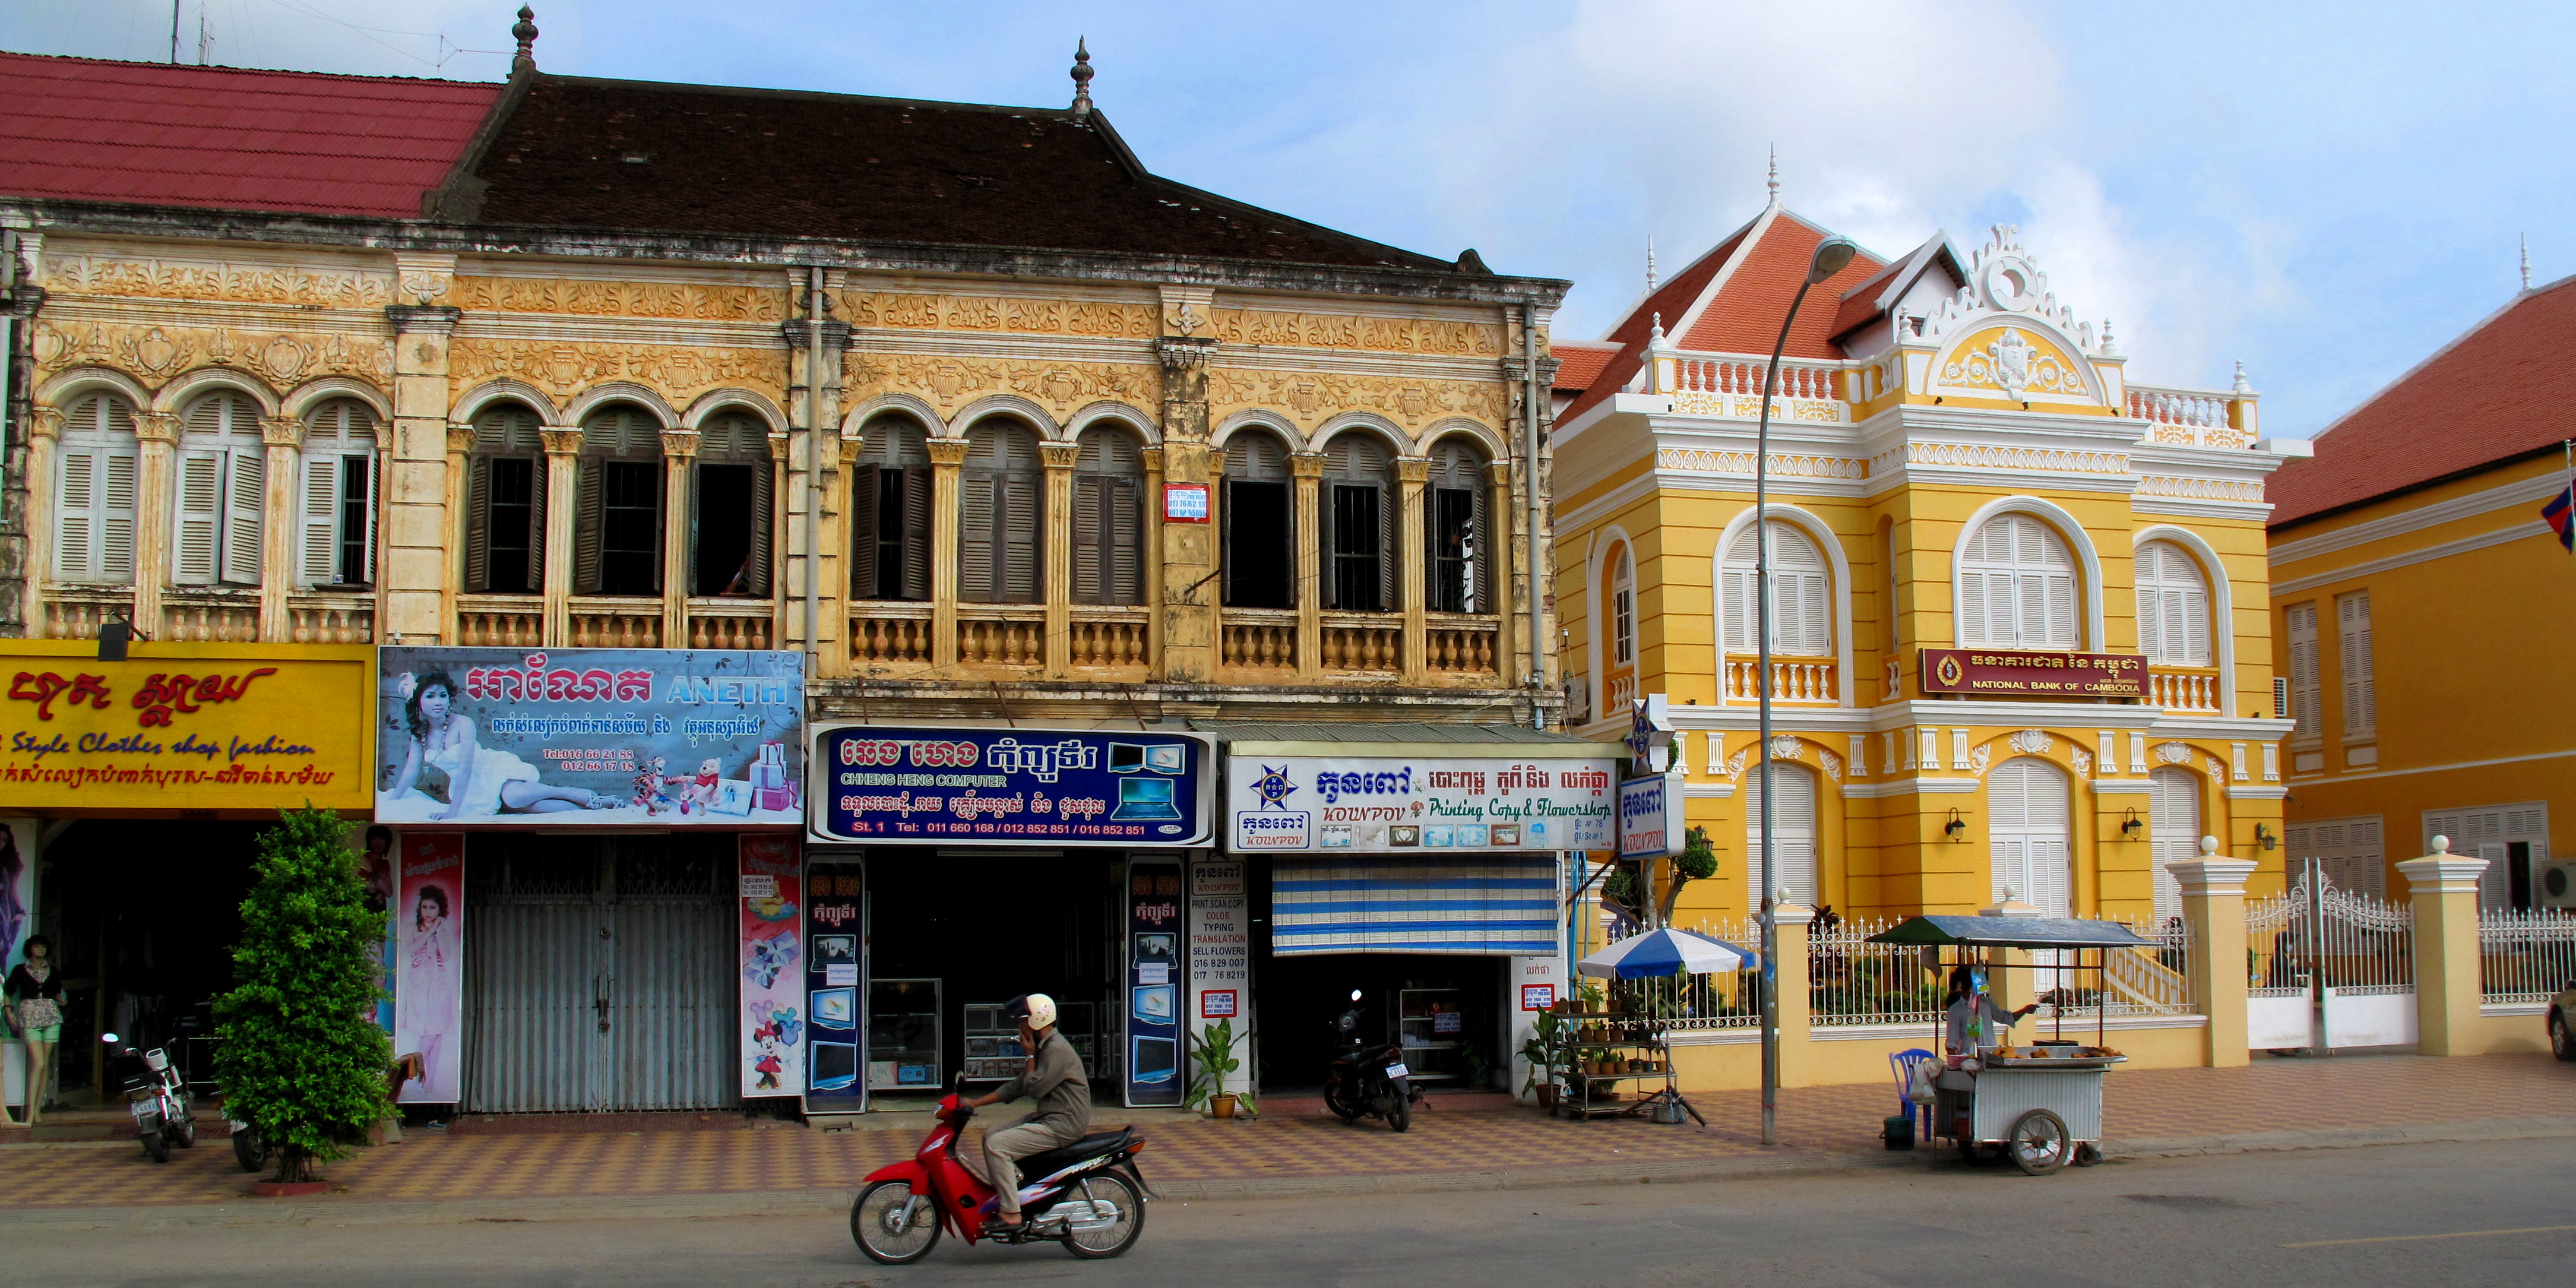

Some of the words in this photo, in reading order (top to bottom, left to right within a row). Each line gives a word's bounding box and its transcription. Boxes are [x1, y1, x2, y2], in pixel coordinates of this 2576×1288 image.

[2068, 653, 2088, 668] នៃ
[2093, 659, 2138, 679] កម្ពុជា
[666, 676, 788, 705] ANETH
[1973, 681, 2027, 689] NATIONAL
[2084, 683, 2140, 692] CAMBODIA
[653, 713, 671, 734] និង
[11, 731, 69, 760] Style
[78, 732, 163, 755] Clothes
[171, 733, 221, 761] shop
[229, 735, 315, 761] fashion
[585, 749, 602, 759] 66
[602, 749, 617, 759] 21
[619, 749, 634, 760] 88
[562, 761, 584, 771] 012
[587, 761, 602, 771] 66
[604, 761, 618, 771] 17
[621, 761, 635, 771] 18
[841, 773, 895, 785] CHHENG
[897, 774, 934, 786] HENG
[936, 774, 1007, 787] COMPUTER
[1317, 765, 1412, 804] កូនពៅ
[1526, 764, 1550, 788] និង
[1561, 766, 1608, 796] លក់ផ្កា
[1031, 792, 1052, 813] និង
[1059, 797, 1105, 821] ជួសជុល
[1429, 798, 1484, 822] Printing
[1489, 798, 1521, 822] Copy
[1523, 798, 1533, 816] &
[1536, 798, 1612, 820] Flowershop
[1623, 781, 1663, 829] កូនពៅ
[1322, 807, 1406, 821] KOUNPOV
[853, 822, 872, 832] St.
[877, 822, 884, 831] 1
[896, 822, 919, 833] Tel:
[928, 823, 946, 833] 011
[950, 824, 970, 833] 660
[974, 824, 994, 833] 168
[1004, 824, 1024, 833] 012
[1027, 824, 1048, 834] 852
[1050, 825, 1069, 834] 851
[1080, 825, 1100, 834] 016
[1103, 826, 1123, 835] 852
[1125, 826, 1145, 835] 851
[1243, 815, 1304, 834] កូនពៅ
[1596, 819, 1603, 828] 78
[1246, 836, 1303, 845] KOUNPOV
[1195, 865, 1240, 882] កូនពៅ
[1207, 912, 1229, 920] COLOR
[1204, 923, 1233, 932] TYPING
[1193, 947, 1209, 955] SELL
[1211, 947, 1245, 955] FLOWERS
